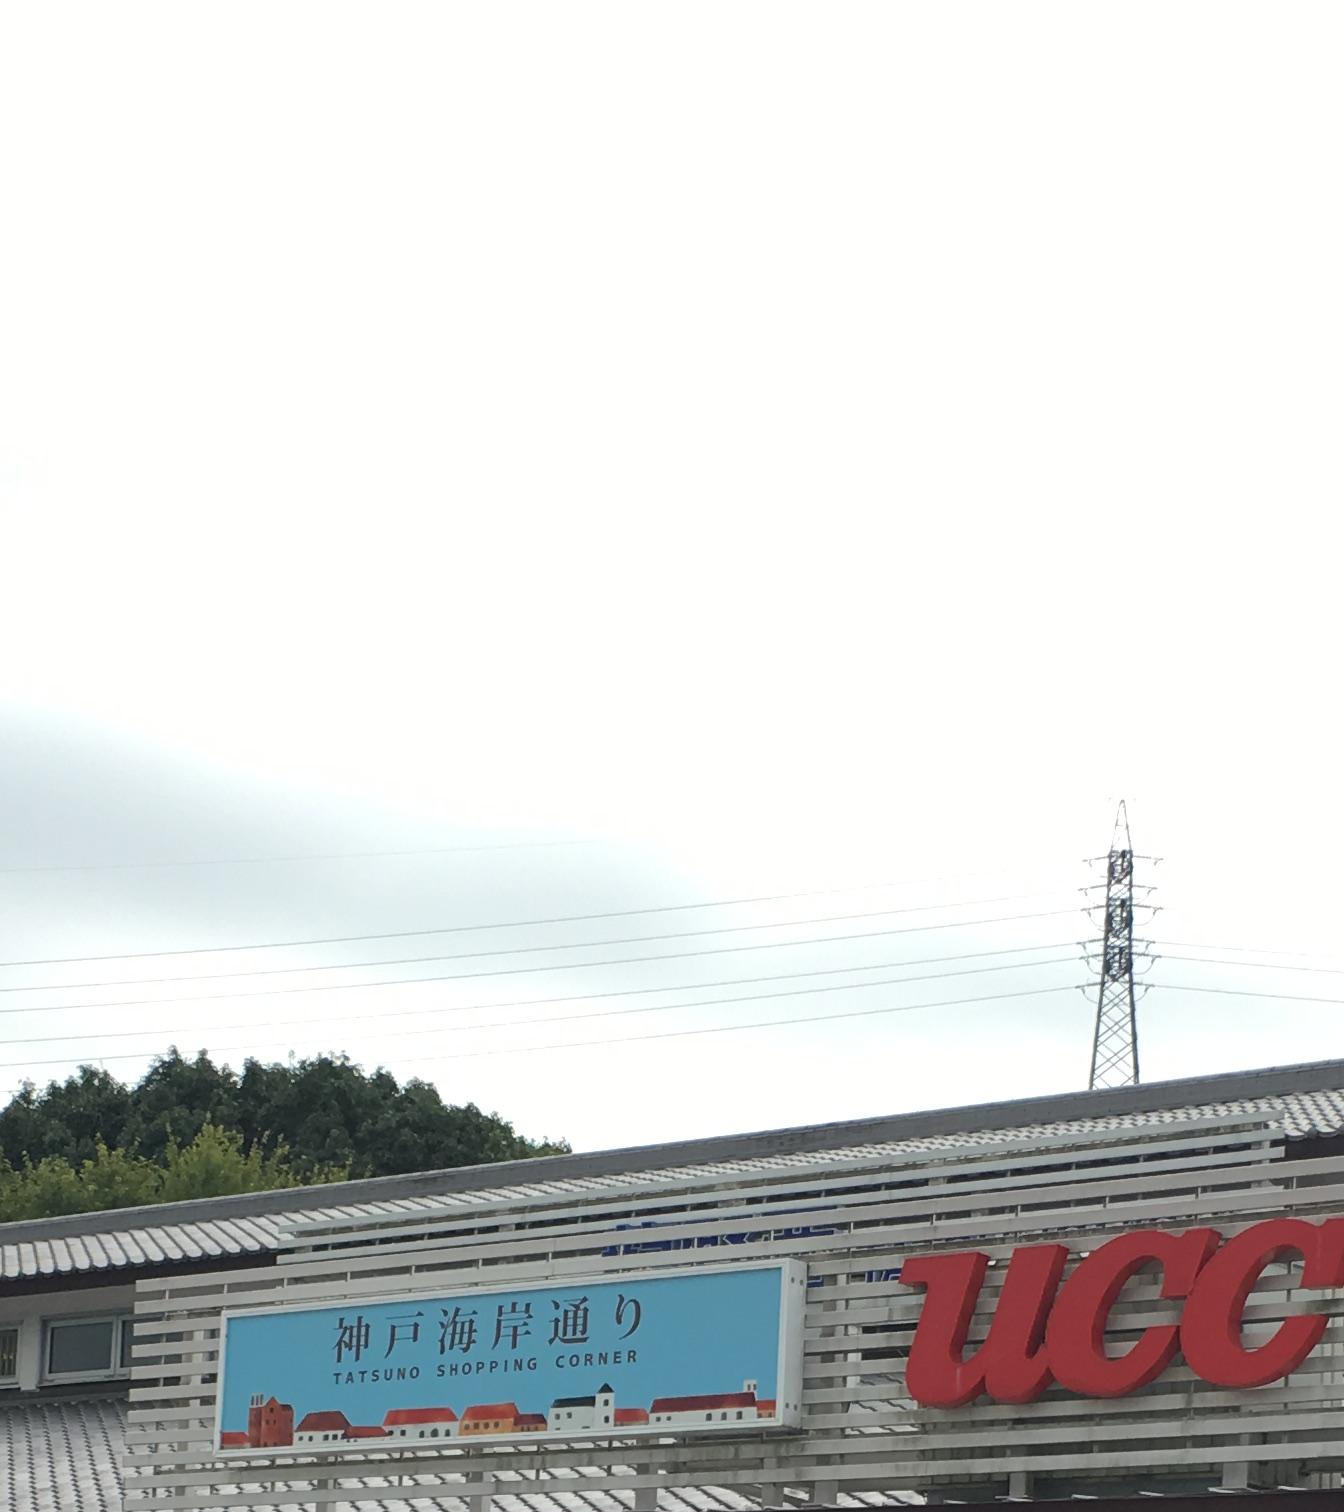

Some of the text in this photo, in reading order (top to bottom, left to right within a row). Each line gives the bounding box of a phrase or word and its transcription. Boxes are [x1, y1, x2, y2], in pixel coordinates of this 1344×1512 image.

[332, 1294, 642, 1363] 神戸海岸通り
[333, 1350, 637, 1385] TATSUNO SHOPPING CORNER
